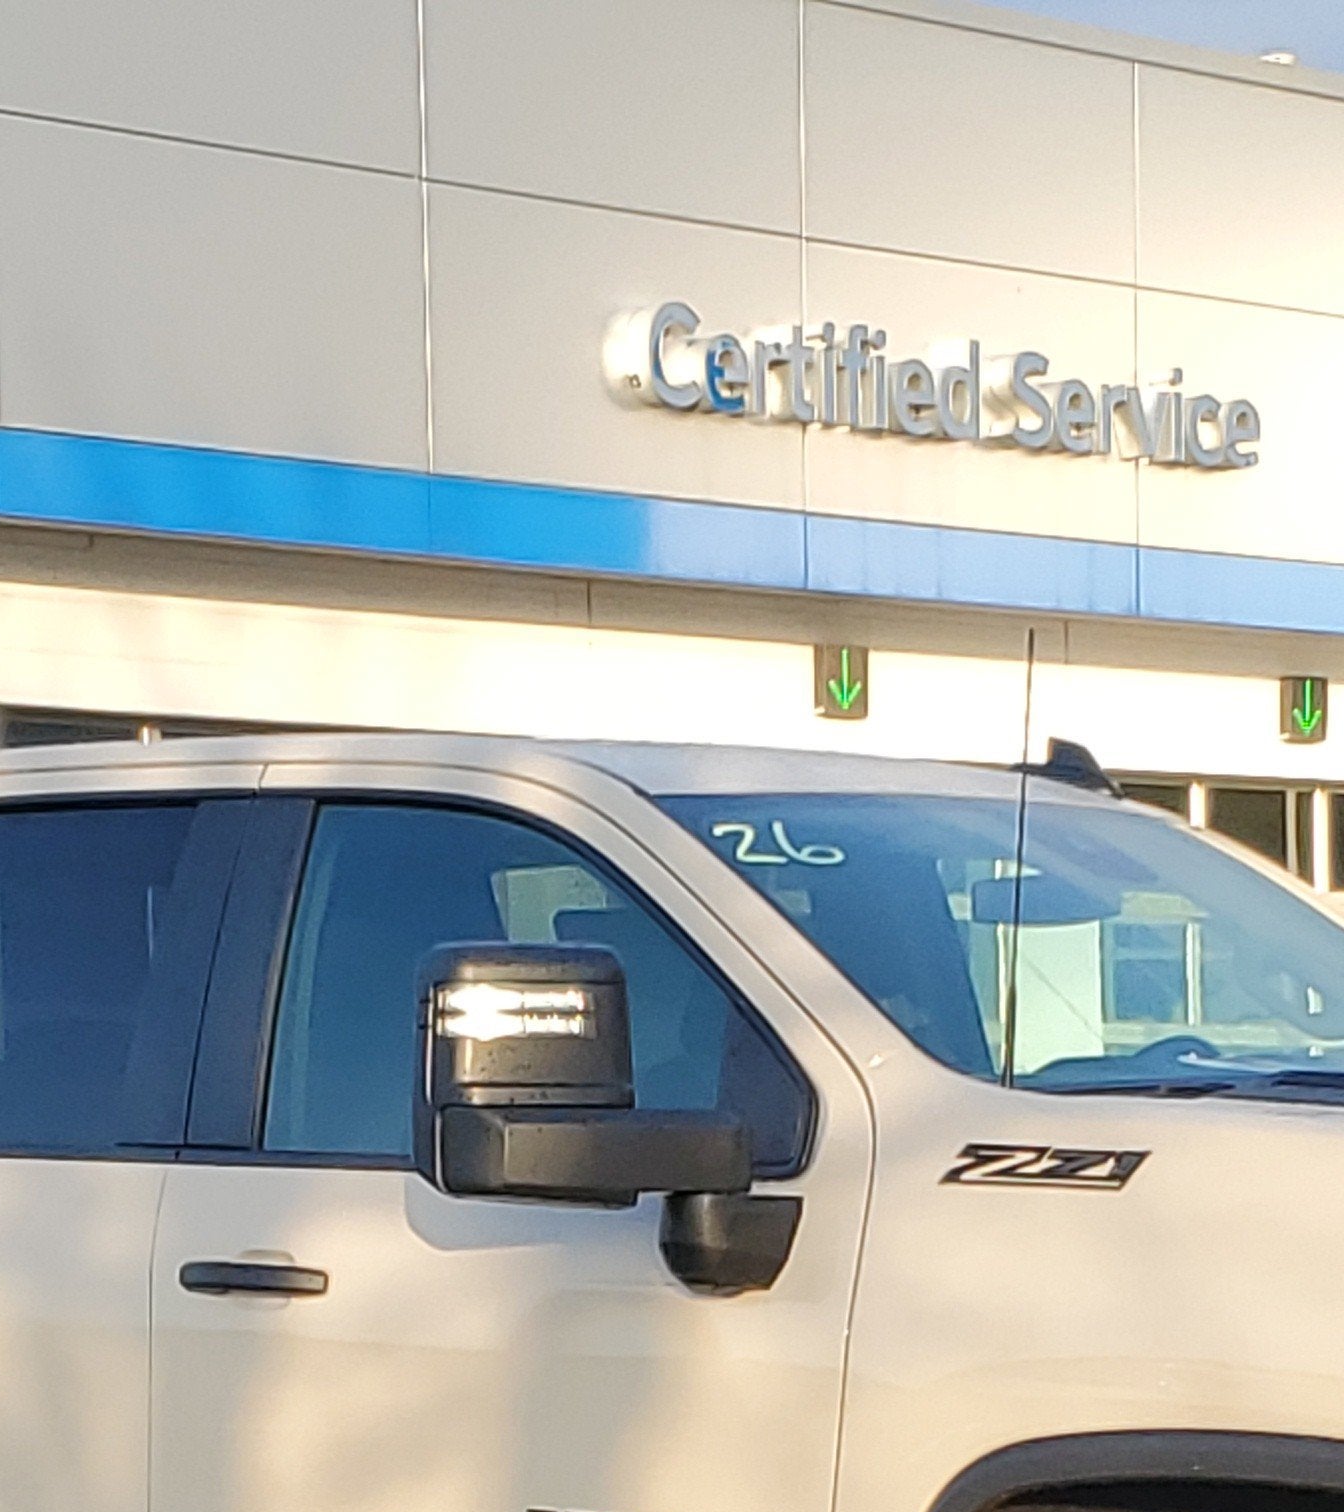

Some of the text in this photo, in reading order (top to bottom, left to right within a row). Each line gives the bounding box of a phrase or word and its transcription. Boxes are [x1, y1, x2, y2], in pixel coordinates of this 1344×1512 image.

[649, 301, 1261, 468] Certified Service
[712, 820, 844, 865] 26
[939, 1143, 1152, 1190] Z71
